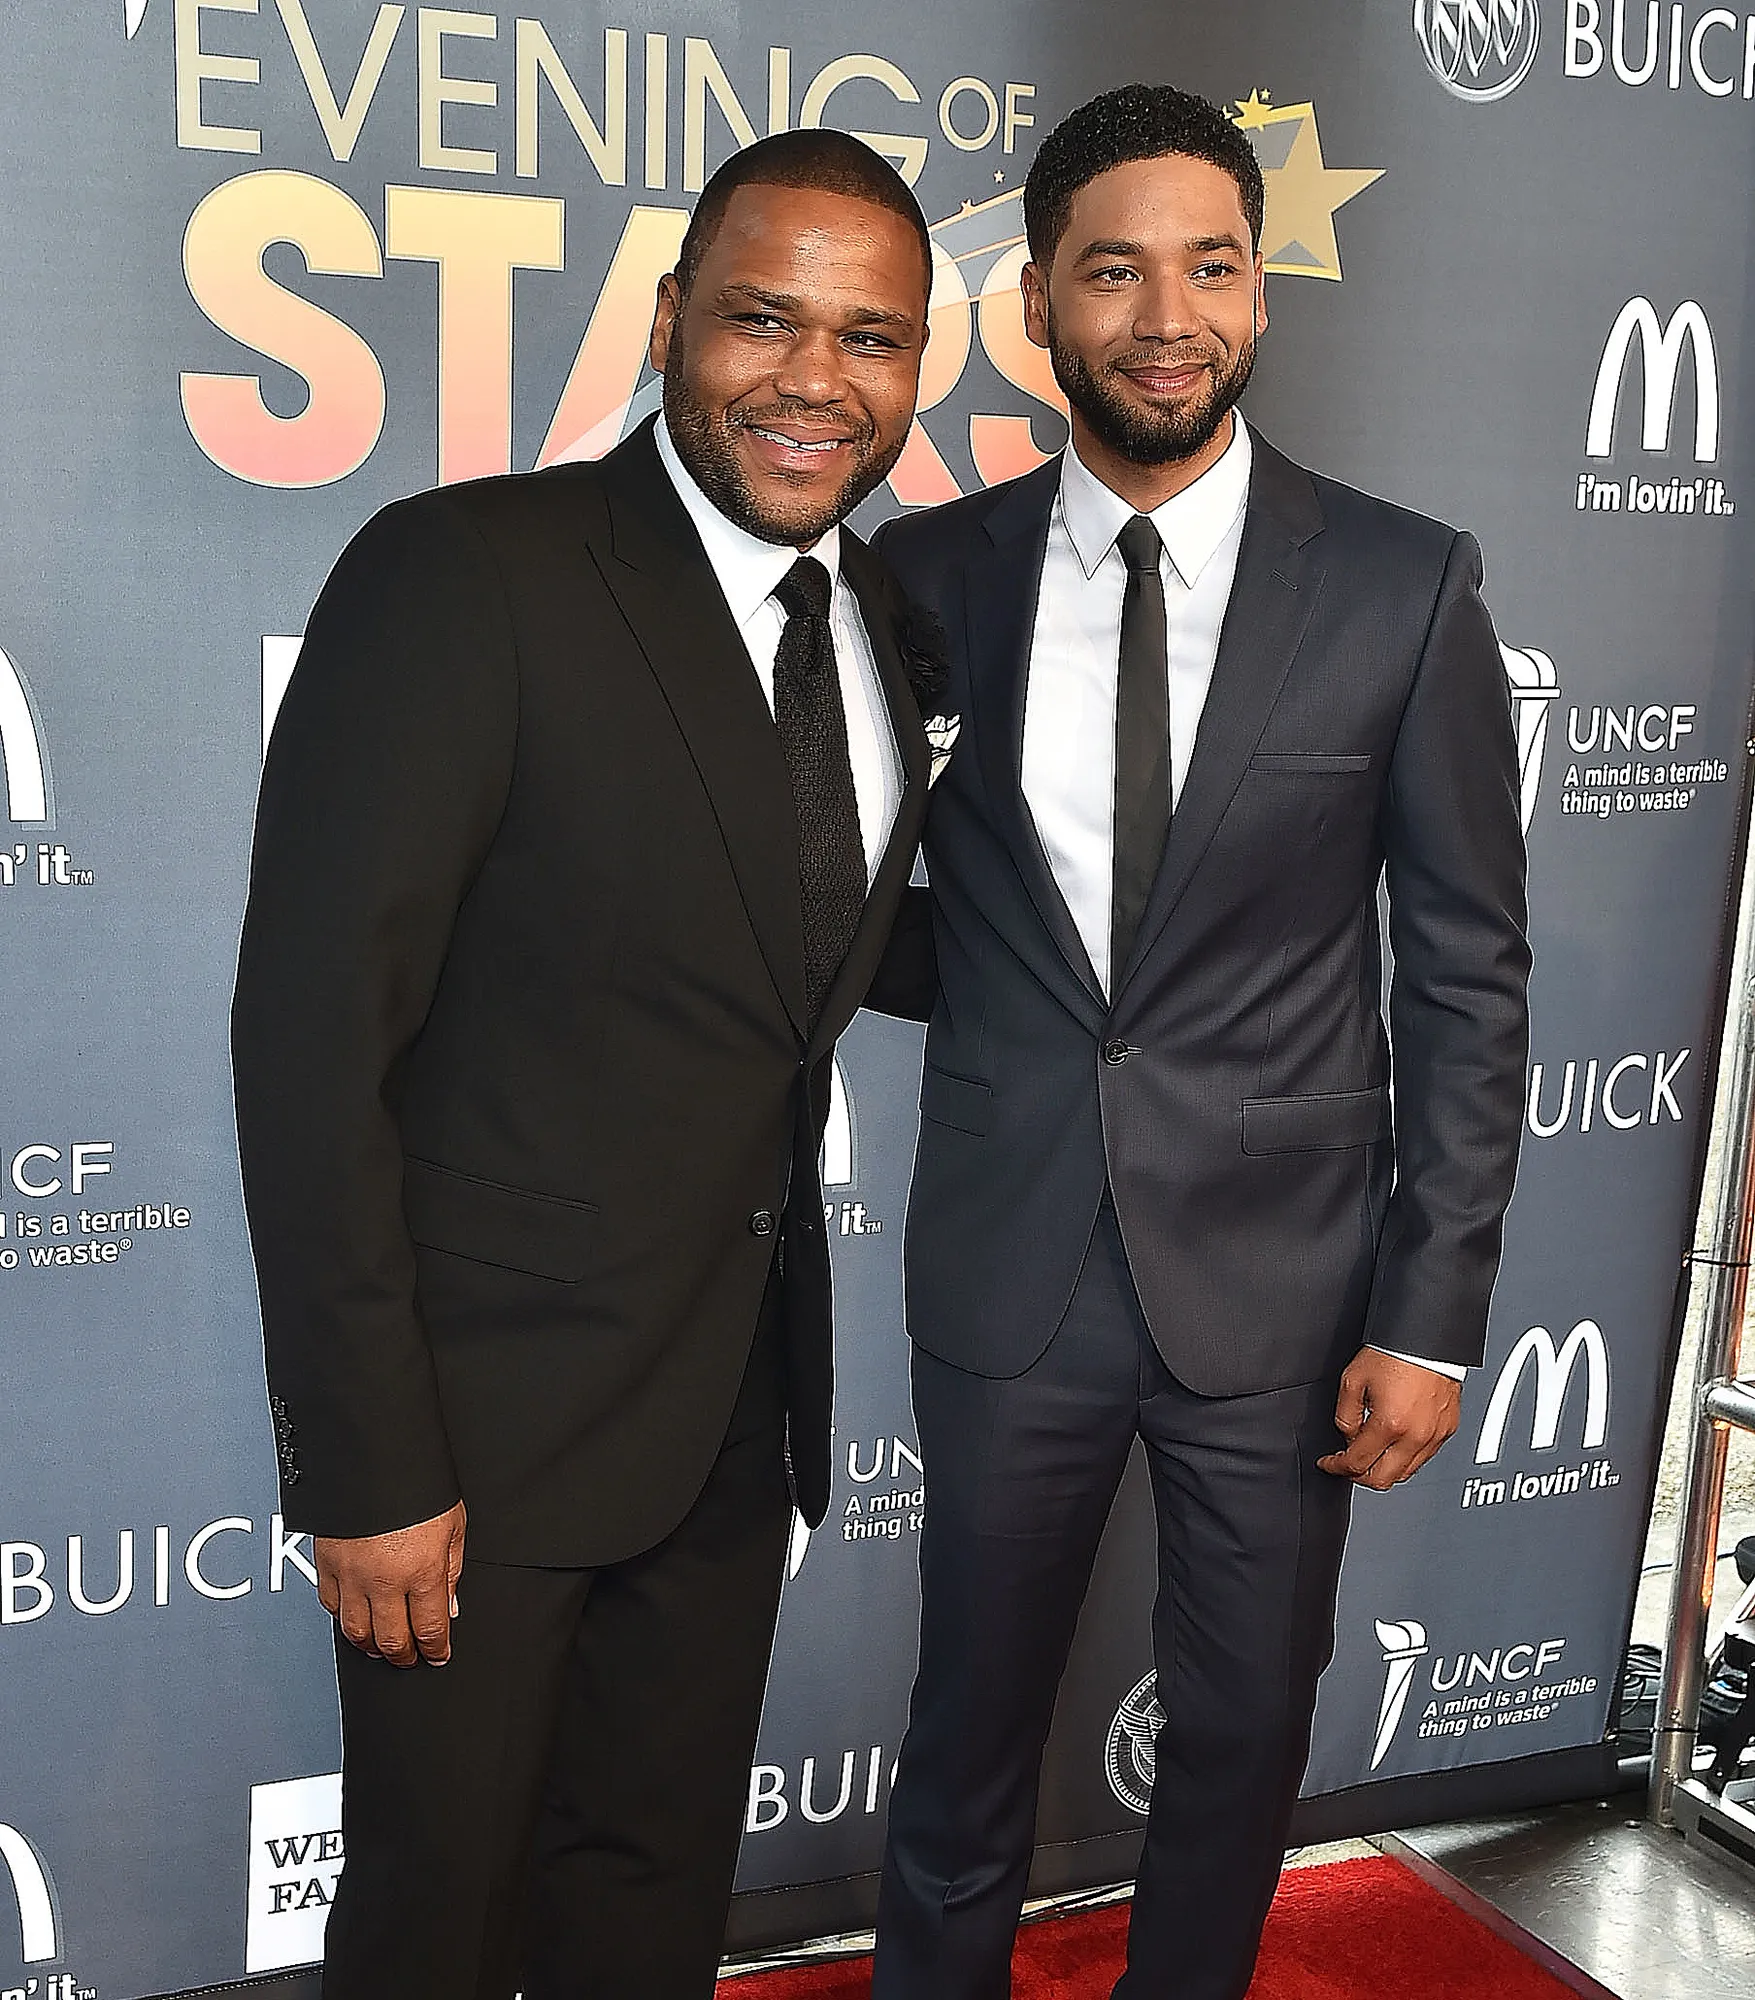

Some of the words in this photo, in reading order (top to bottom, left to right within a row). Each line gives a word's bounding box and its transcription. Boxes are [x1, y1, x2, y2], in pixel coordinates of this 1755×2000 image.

[175, 0, 929, 195] EVENING
[938, 76, 1036, 154] OF
[1576, 473, 1622, 510] i'm
[1627, 475, 1704, 514] lovin'
[1567, 704, 1697, 754] UNCF
[1563, 764, 1580, 788] A
[1584, 762, 1632, 787] mind
[1634, 762, 1650, 786] is
[1653, 765, 1667, 785] a
[1669, 758, 1728, 784] terrible
[1561, 790, 1612, 819] thing
[1615, 790, 1635, 812] to
[1527, 1047, 1692, 1139] UICK
[16, 1211, 42, 1238] is
[51, 1214, 70, 1236] a
[78, 1202, 192, 1235] terrible
[842, 1494, 863, 1517] A
[868, 1484, 925, 1514] mind
[1461, 1478, 1506, 1509] i'm
[1511, 1461, 1590, 1501] lovin'
[841, 1516, 902, 1542] thing
[0, 1513, 319, 1626] BUICK
[1430, 1637, 1567, 1693] UNCF
[1422, 1700, 1440, 1719] A
[1442, 1691, 1493, 1716] mind
[1494, 1689, 1511, 1709] is
[1514, 1689, 1529, 1705] a
[1531, 1675, 1598, 1702] terrible
[1417, 1715, 1469, 1739] thing
[1471, 1712, 1492, 1731] to
[745, 1745, 899, 1834] BUI
[268, 1875, 341, 1914] FA
